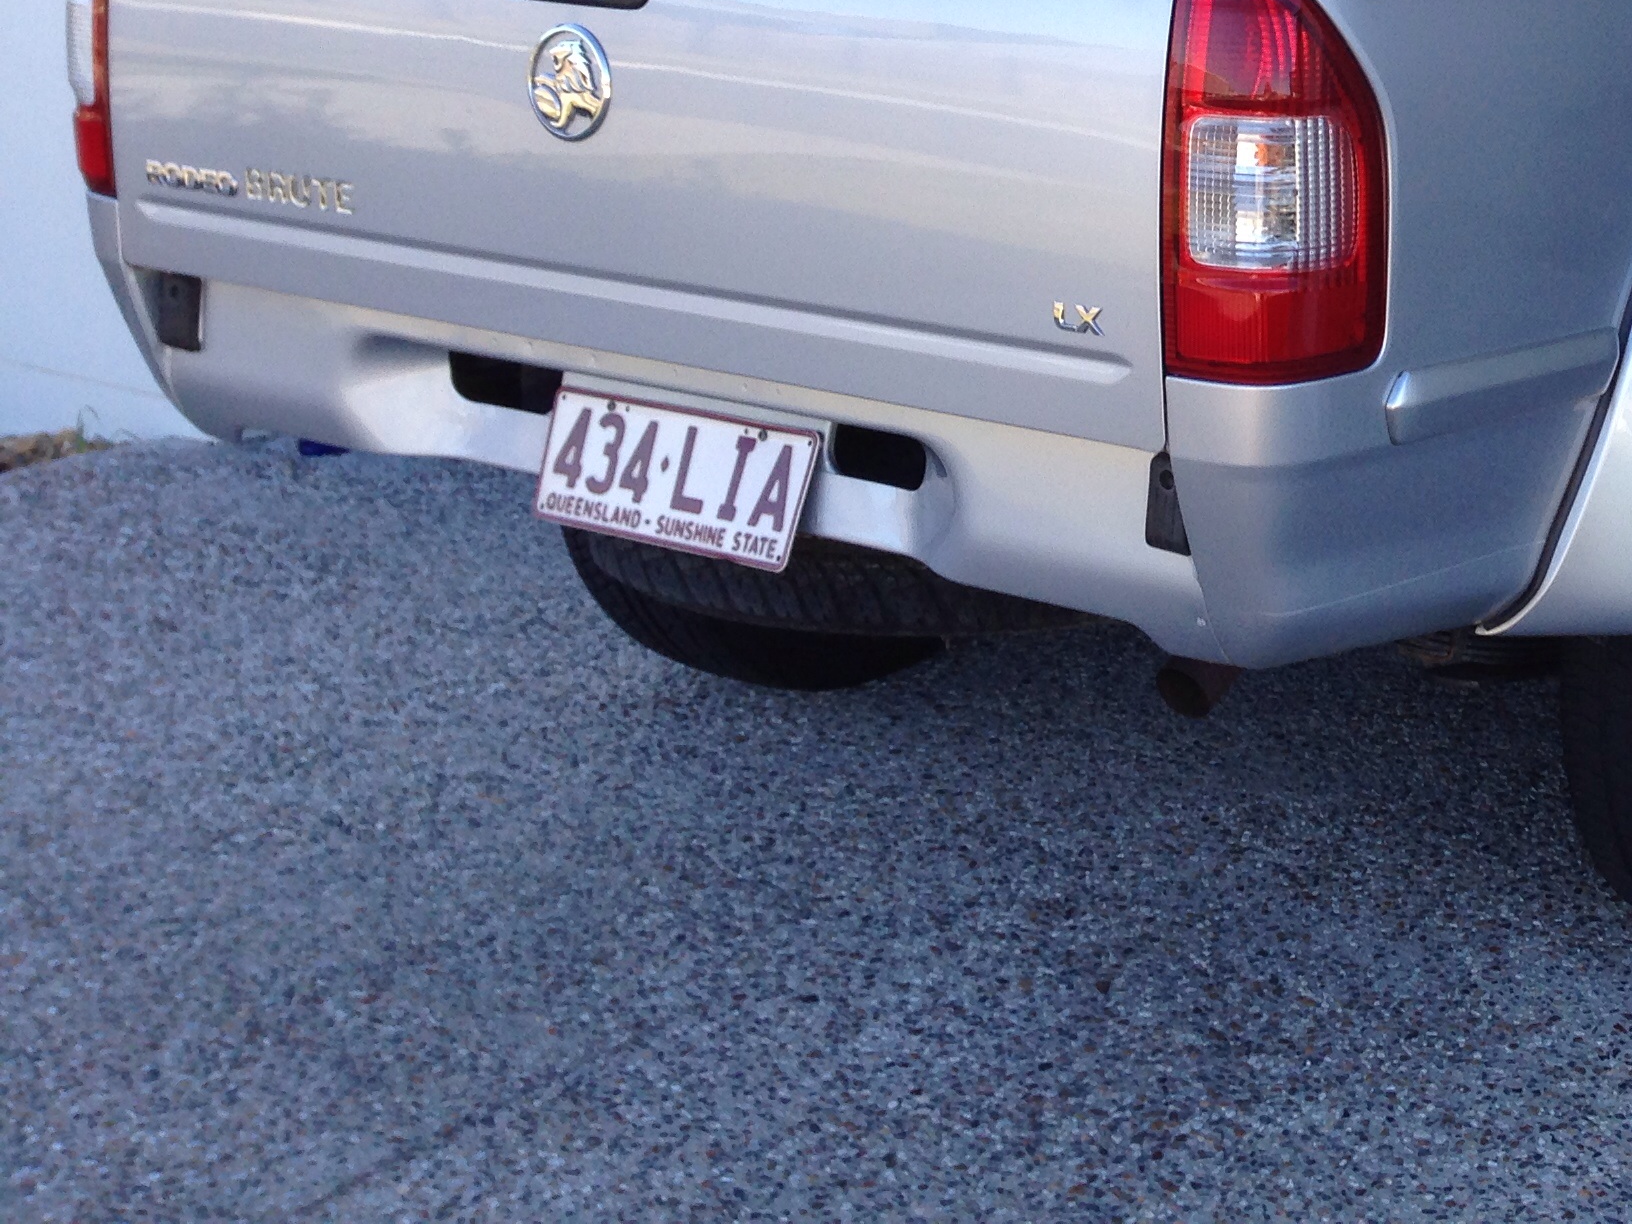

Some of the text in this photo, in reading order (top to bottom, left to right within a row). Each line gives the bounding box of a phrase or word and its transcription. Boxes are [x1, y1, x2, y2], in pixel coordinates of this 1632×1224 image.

[146, 159, 354, 216] RODEO BRUTE
[1053, 300, 1105, 336] LX
[545, 492, 779, 560] QUEENSLAND SUNSHINE STATE
